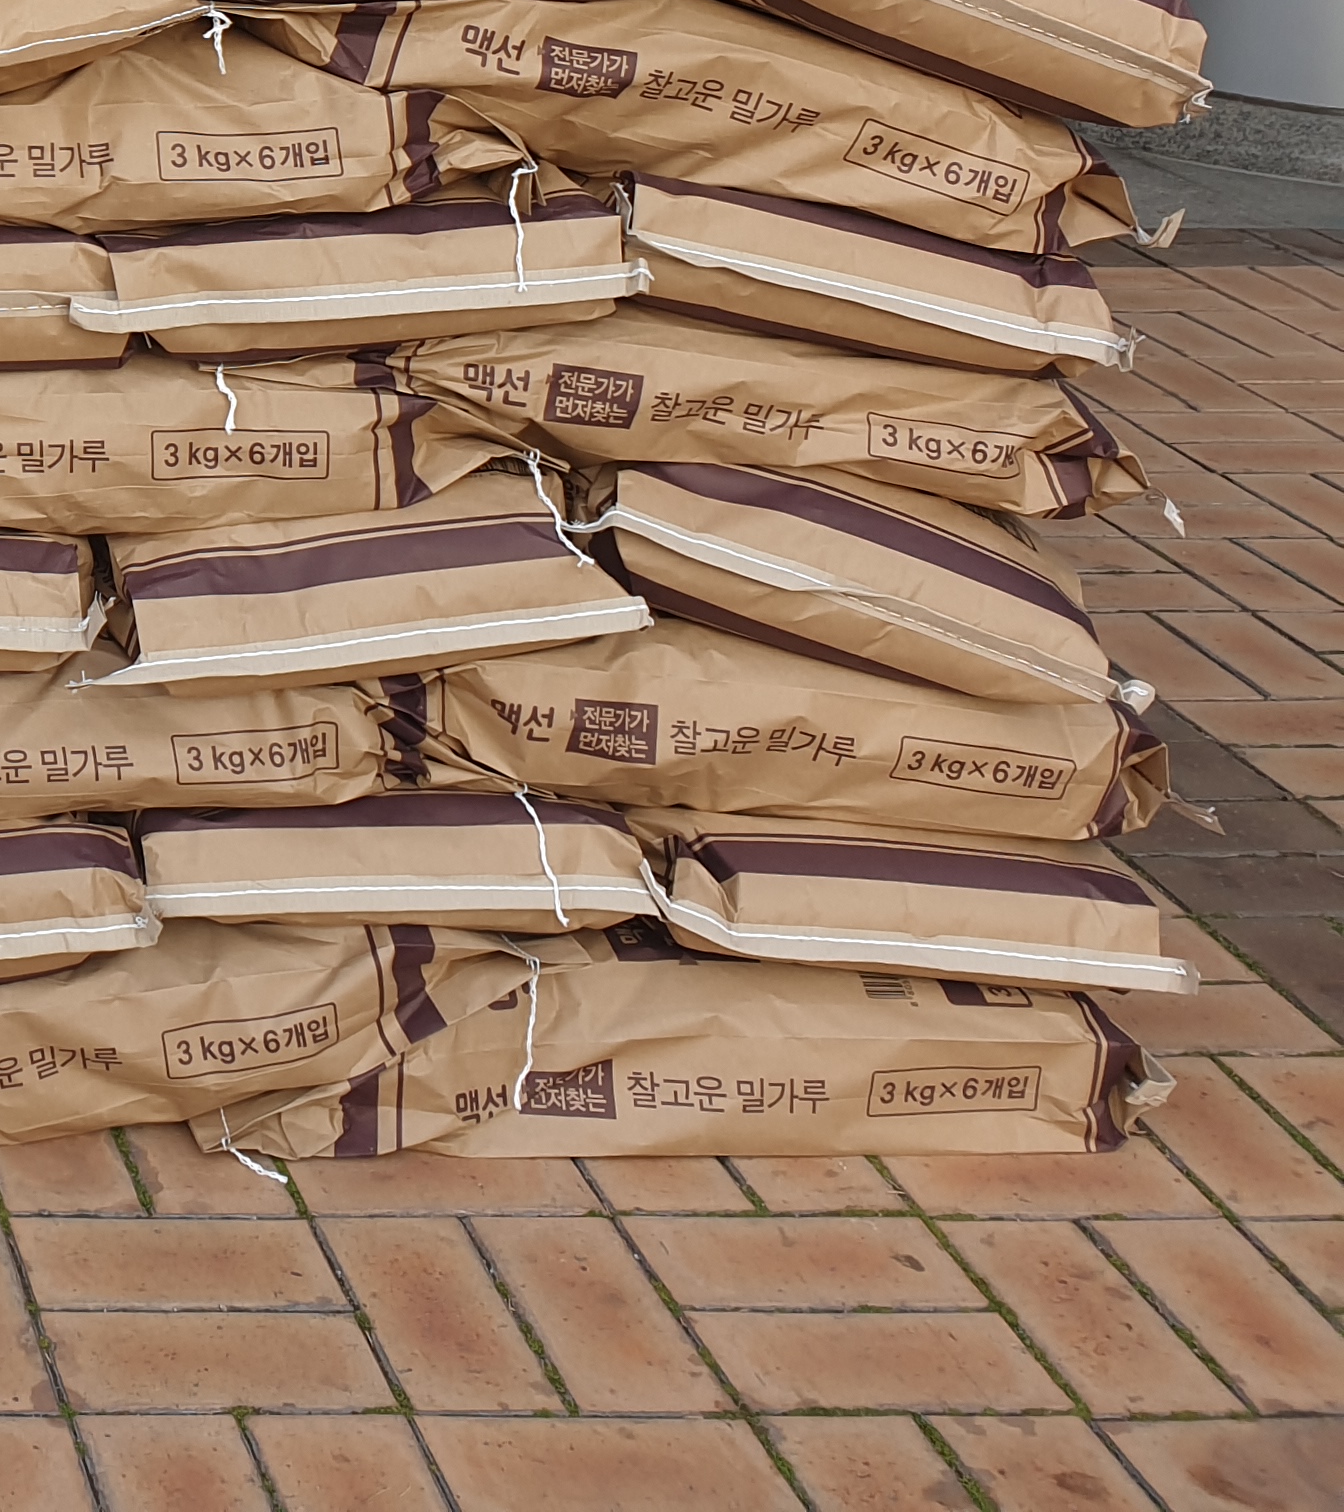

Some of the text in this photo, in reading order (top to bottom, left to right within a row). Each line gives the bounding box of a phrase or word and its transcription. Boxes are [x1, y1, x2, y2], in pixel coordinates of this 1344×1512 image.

[460, 23, 526, 76] 맥선
[549, 42, 629, 77] 전문가가
[640, 68, 821, 133] 찰고운 밀가루
[25, 142, 116, 180] 밀가루
[461, 362, 532, 409] 맥선
[556, 372, 636, 402] 전문가가
[554, 394, 629, 426] 먼저찾는
[650, 391, 736, 426] 찰고운
[15, 438, 111, 477] 밀가루
[581, 704, 651, 734] 전문가가
[578, 730, 648, 759] 먼저찾는
[669, 719, 858, 766] 찰고운 밀가루
[39, 744, 136, 784] 밀가루
[28, 1046, 123, 1080] 밀가루
[626, 1070, 729, 1112] 찰고운
[736, 1080, 830, 1116] 밀가루
